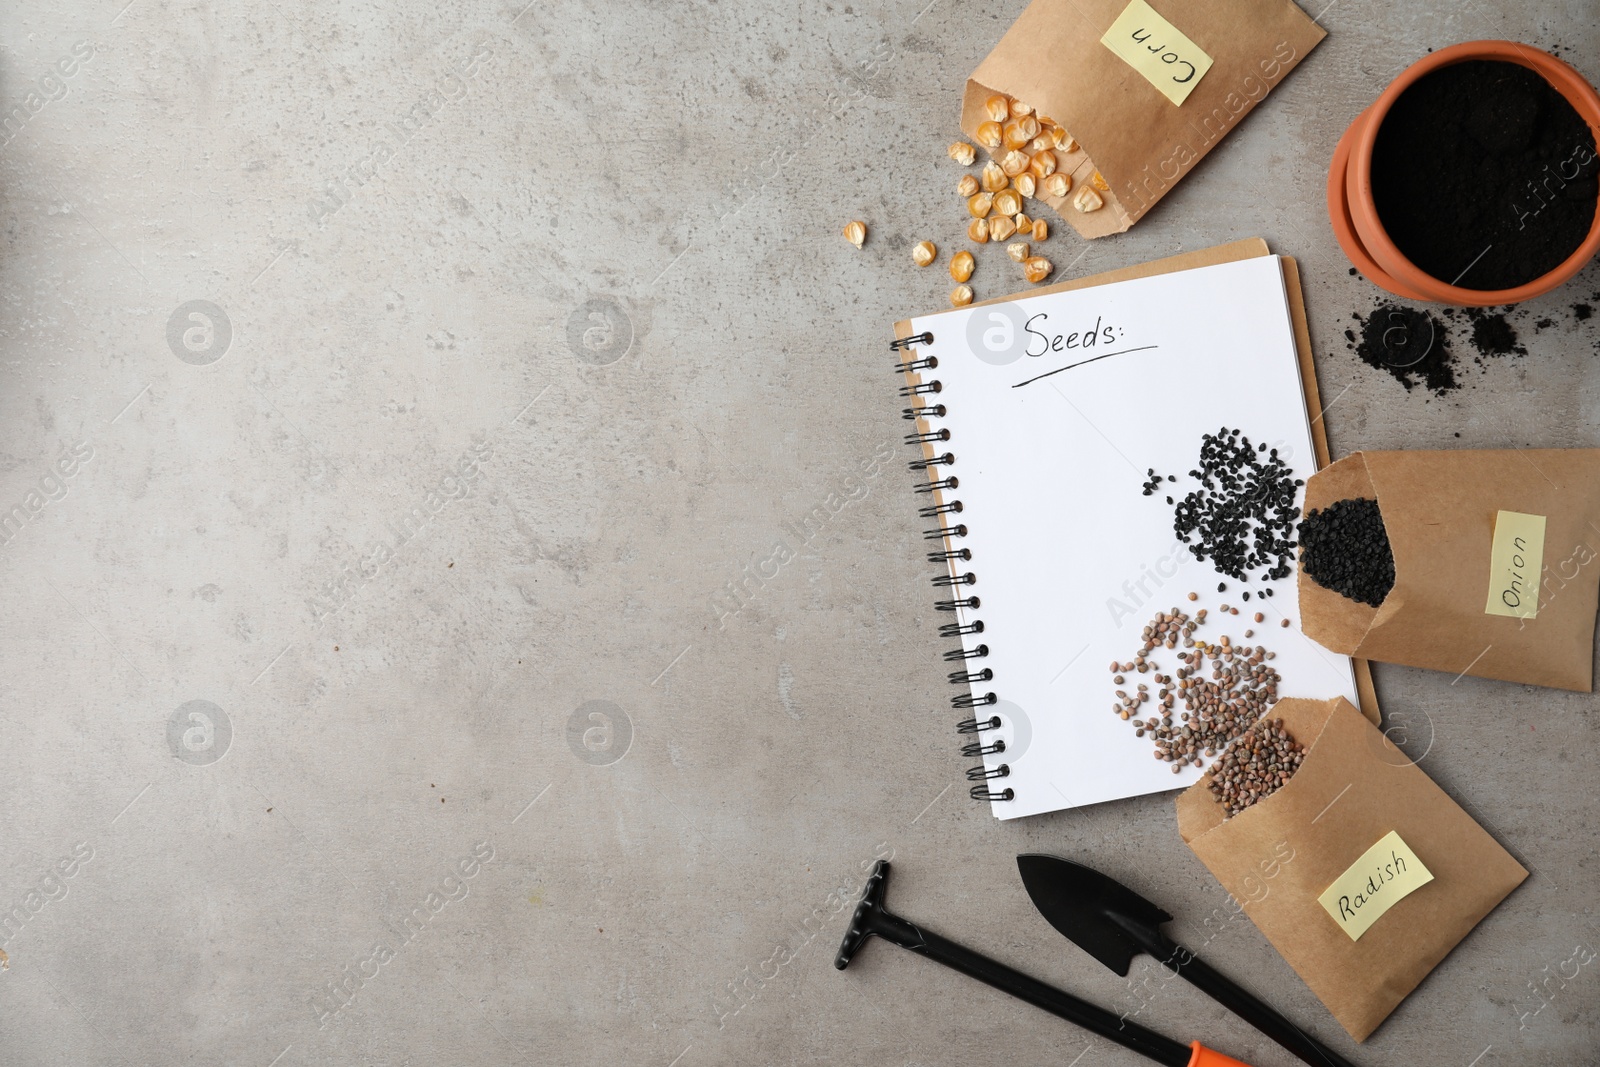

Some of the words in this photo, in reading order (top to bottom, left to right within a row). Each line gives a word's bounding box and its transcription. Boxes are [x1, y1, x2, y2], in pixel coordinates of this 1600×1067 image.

[1132, 27, 1195, 83] Corn
[1024, 313, 1124, 357] Seeds:
[1502, 537, 1526, 607] Onion
[1338, 851, 1407, 921] Radish
